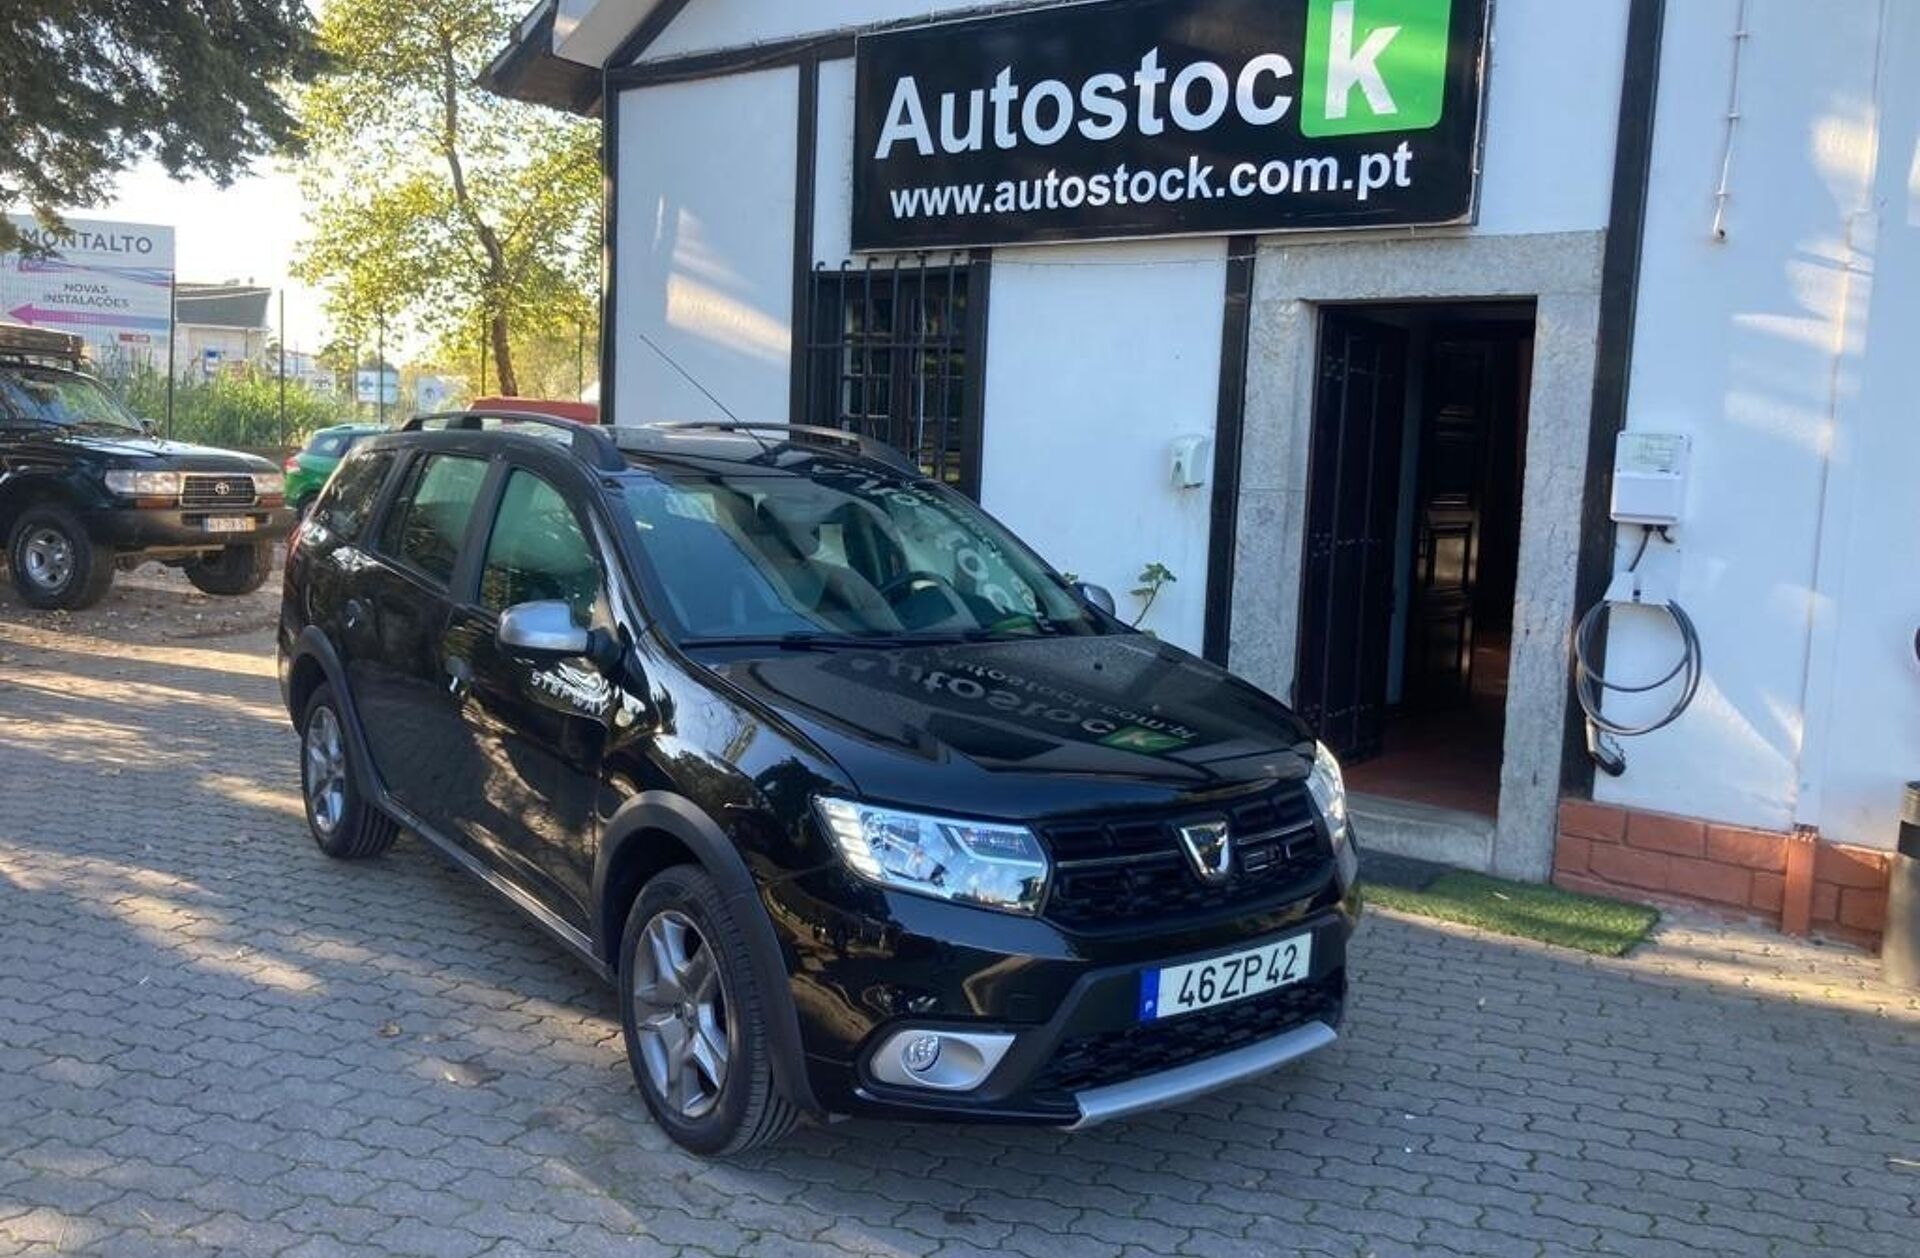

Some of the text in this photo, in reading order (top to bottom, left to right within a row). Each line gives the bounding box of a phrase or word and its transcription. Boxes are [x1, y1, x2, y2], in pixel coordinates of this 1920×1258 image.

[874, 0, 1402, 160] Autostock
[890, 142, 1414, 219] www.autostock.com.pt
[22, 228, 153, 254] MONTALTO
[43, 293, 130, 308] INSTALAÇÕES
[64, 283, 109, 294] NOVAS
